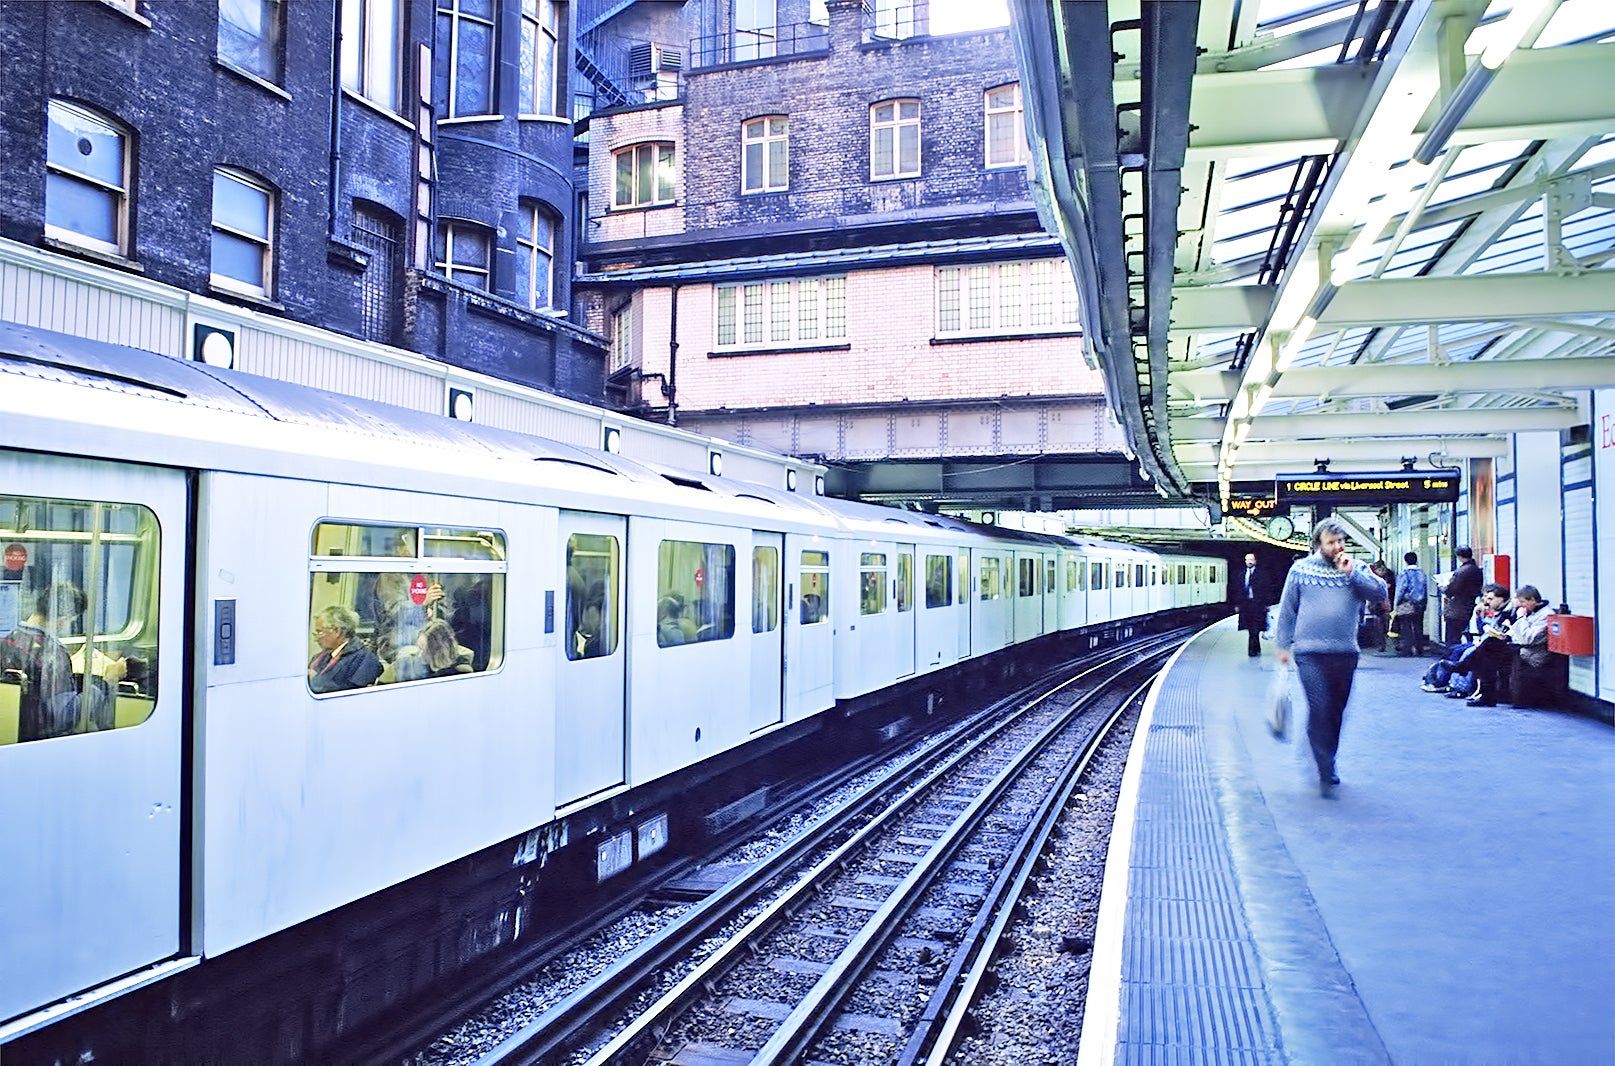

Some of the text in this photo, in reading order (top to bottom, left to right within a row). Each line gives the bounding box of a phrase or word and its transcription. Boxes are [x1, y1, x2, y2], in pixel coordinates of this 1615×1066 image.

[1287, 482, 1291, 491] 1
[1294, 482, 1320, 491] CIRCLE
[1322, 482, 1340, 490] LINE
[1350, 481, 1383, 490] Liverpool
[1384, 481, 1409, 489] Street
[1231, 500, 1275, 509] WAY OUT
